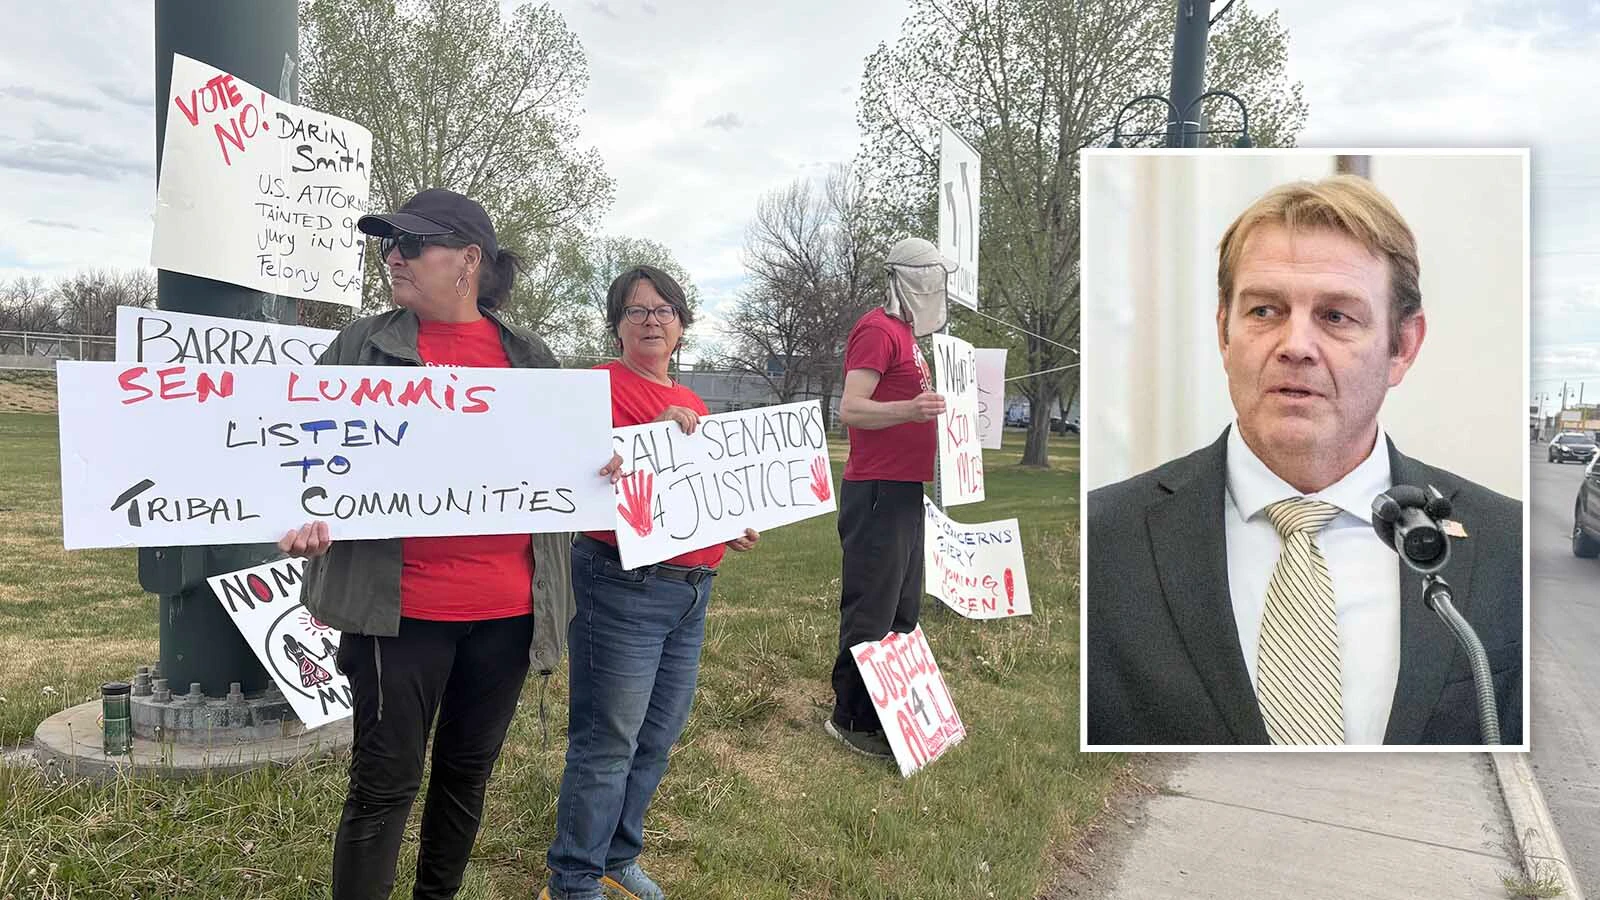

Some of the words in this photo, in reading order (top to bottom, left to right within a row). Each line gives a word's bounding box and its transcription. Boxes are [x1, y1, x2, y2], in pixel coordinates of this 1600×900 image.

[175, 73, 243, 127] VOTE
[213, 92, 270, 166] NO!
[258, 173, 290, 199] U.S.
[257, 254, 320, 293] Felony
[117, 366, 233, 404] SEN
[702, 406, 823, 460] SENATORS
[280, 455, 351, 483] TO
[110, 479, 261, 528] TRIBAL
[653, 494, 666, 528] 4
[669, 460, 817, 540] JUSTICE
[856, 629, 937, 709] JUSTICE
[896, 674, 966, 768] ALL
[911, 686, 931, 726] 4
